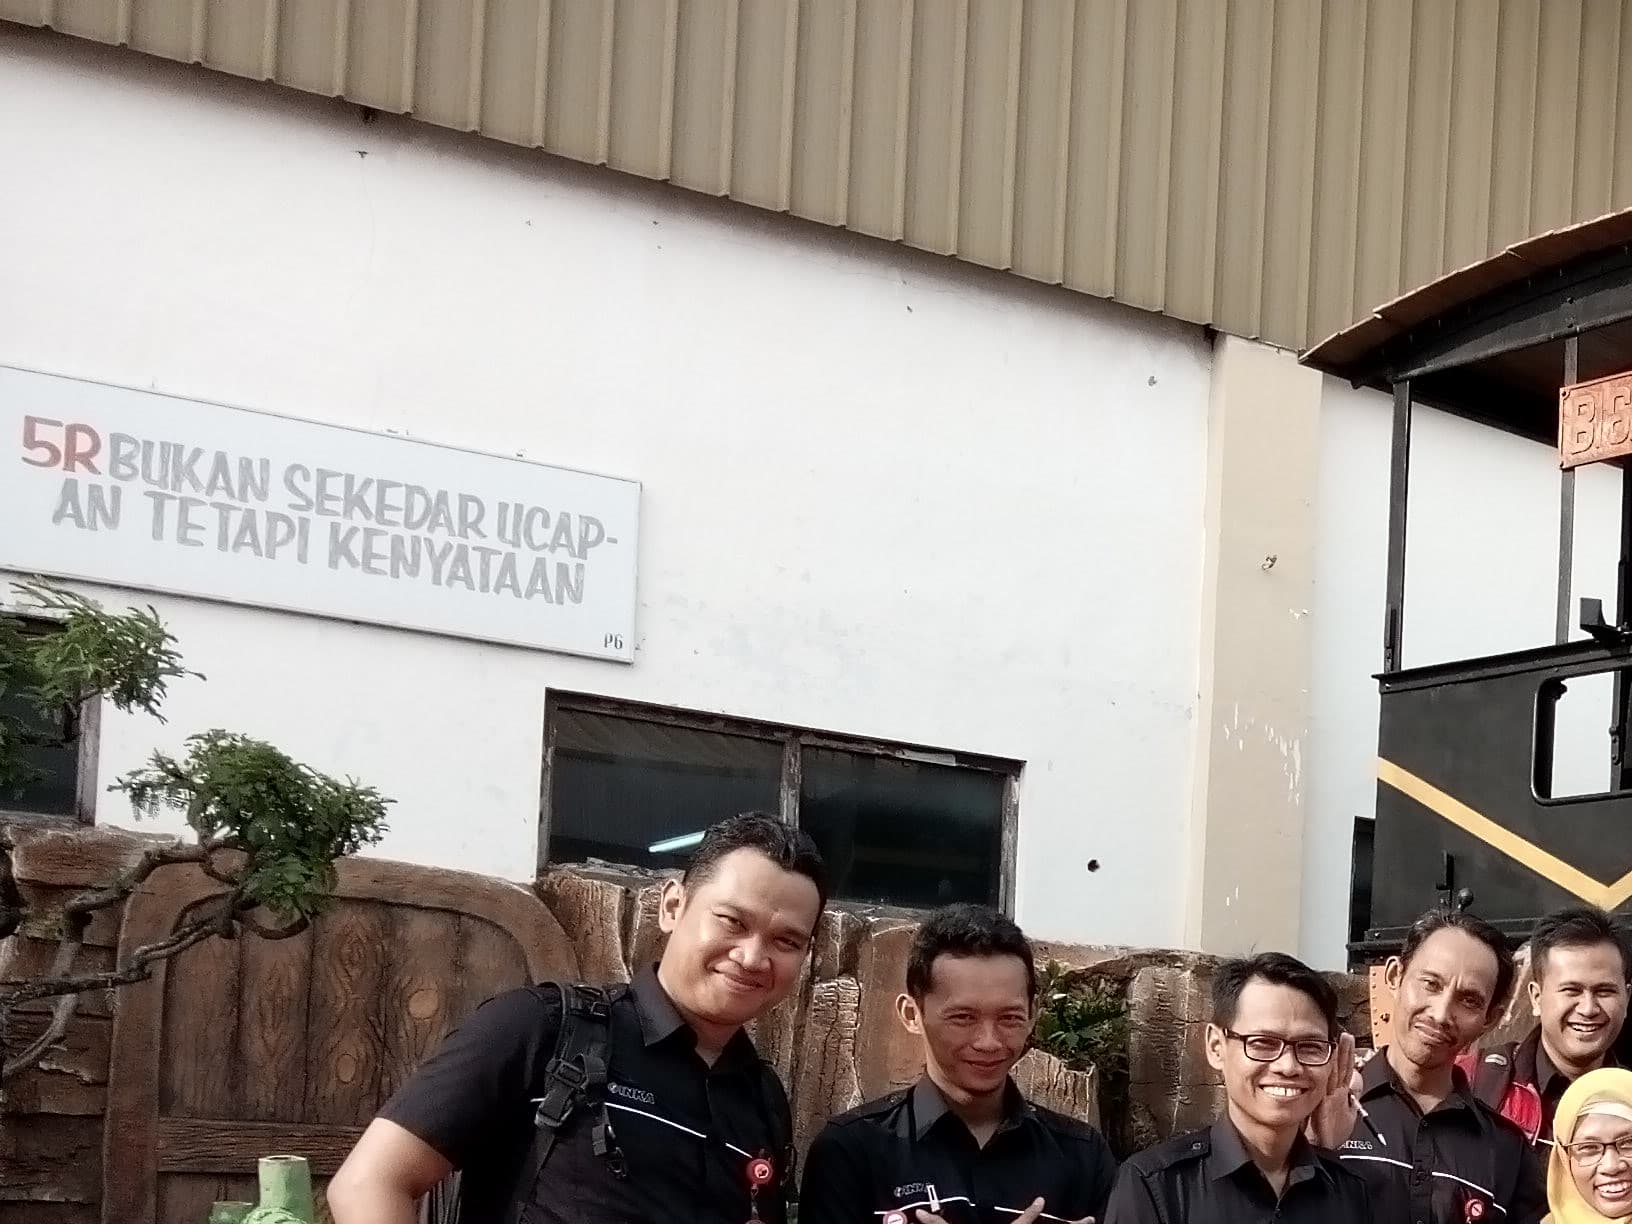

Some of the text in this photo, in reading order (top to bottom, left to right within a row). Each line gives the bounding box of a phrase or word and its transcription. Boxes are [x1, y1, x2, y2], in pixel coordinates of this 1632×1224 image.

[21, 415, 618, 560] 5R BUKAN SEKEDAR UCAP-
[52, 478, 585, 605] AN TETAPI KENYATAAN
[604, 632, 624, 650] P6
